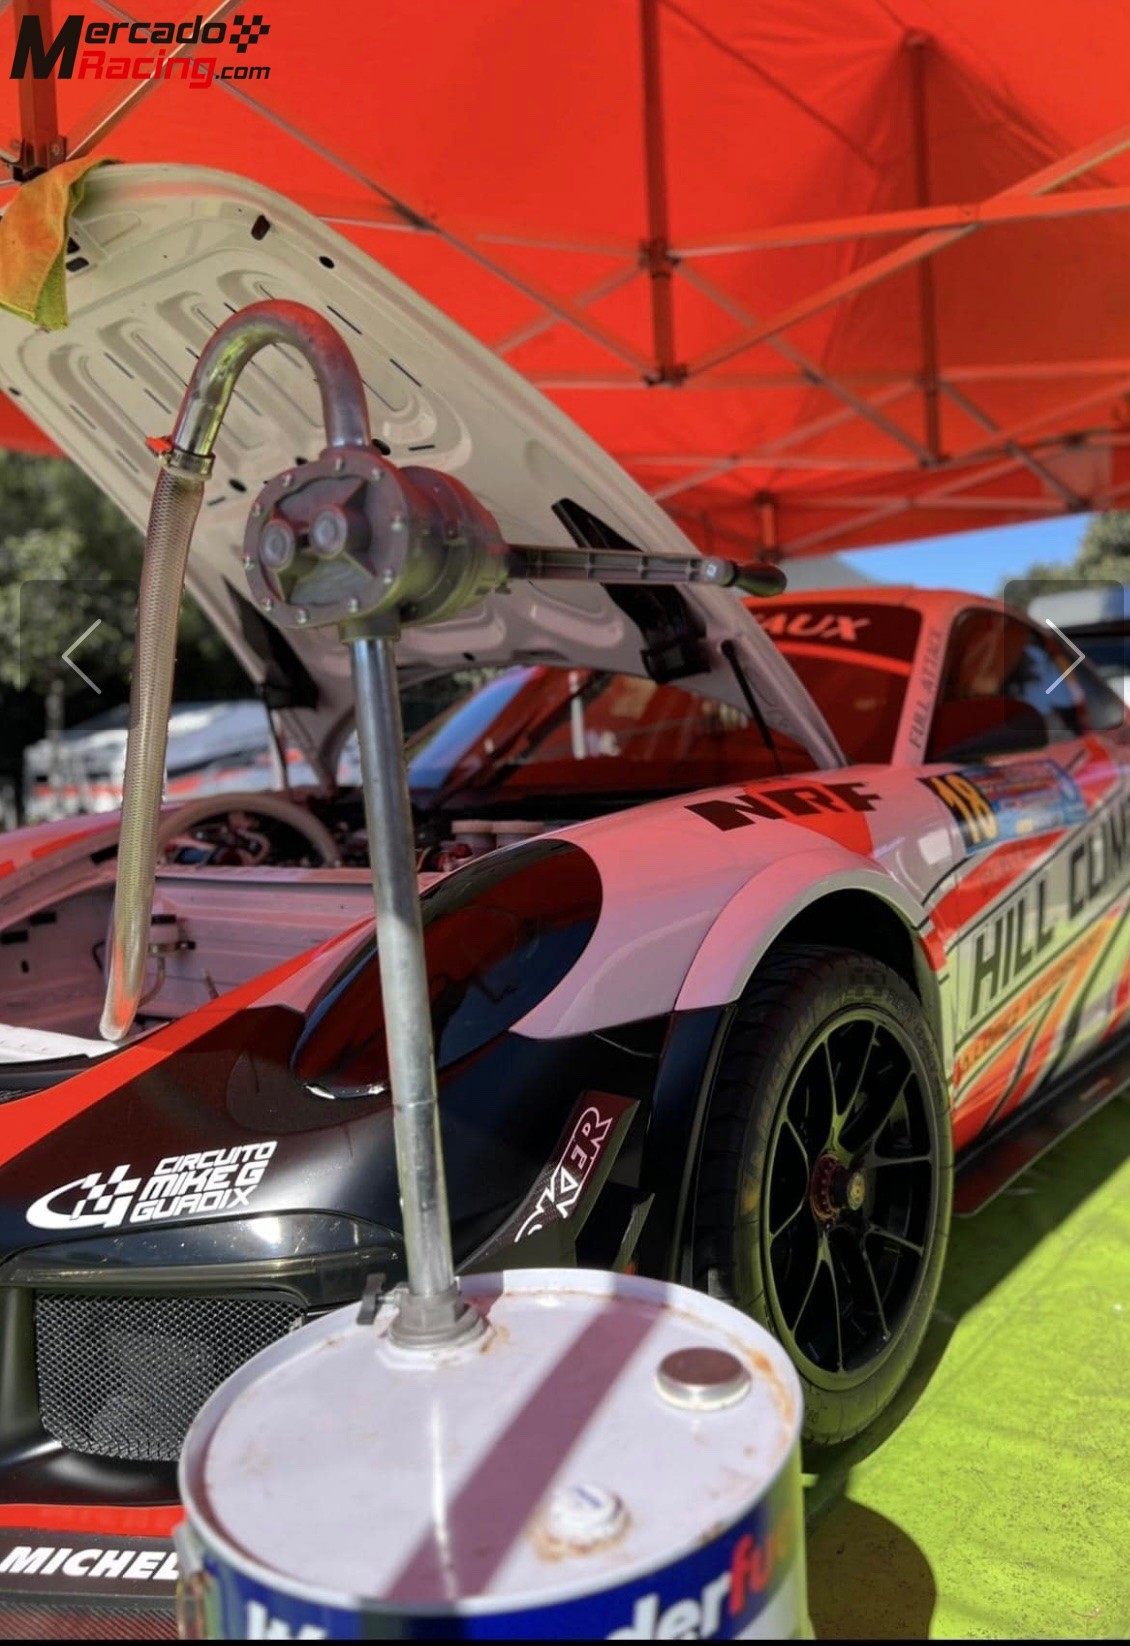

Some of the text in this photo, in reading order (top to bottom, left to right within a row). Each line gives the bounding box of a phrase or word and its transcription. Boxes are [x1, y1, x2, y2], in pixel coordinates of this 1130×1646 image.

[754, 613, 870, 641] AUX
[970, 877, 1056, 1021] HILL
[154, 1140, 278, 1176] CIRCUITO
[138, 1164, 238, 1201] MIKE
[129, 1185, 258, 1223] GUADIX
